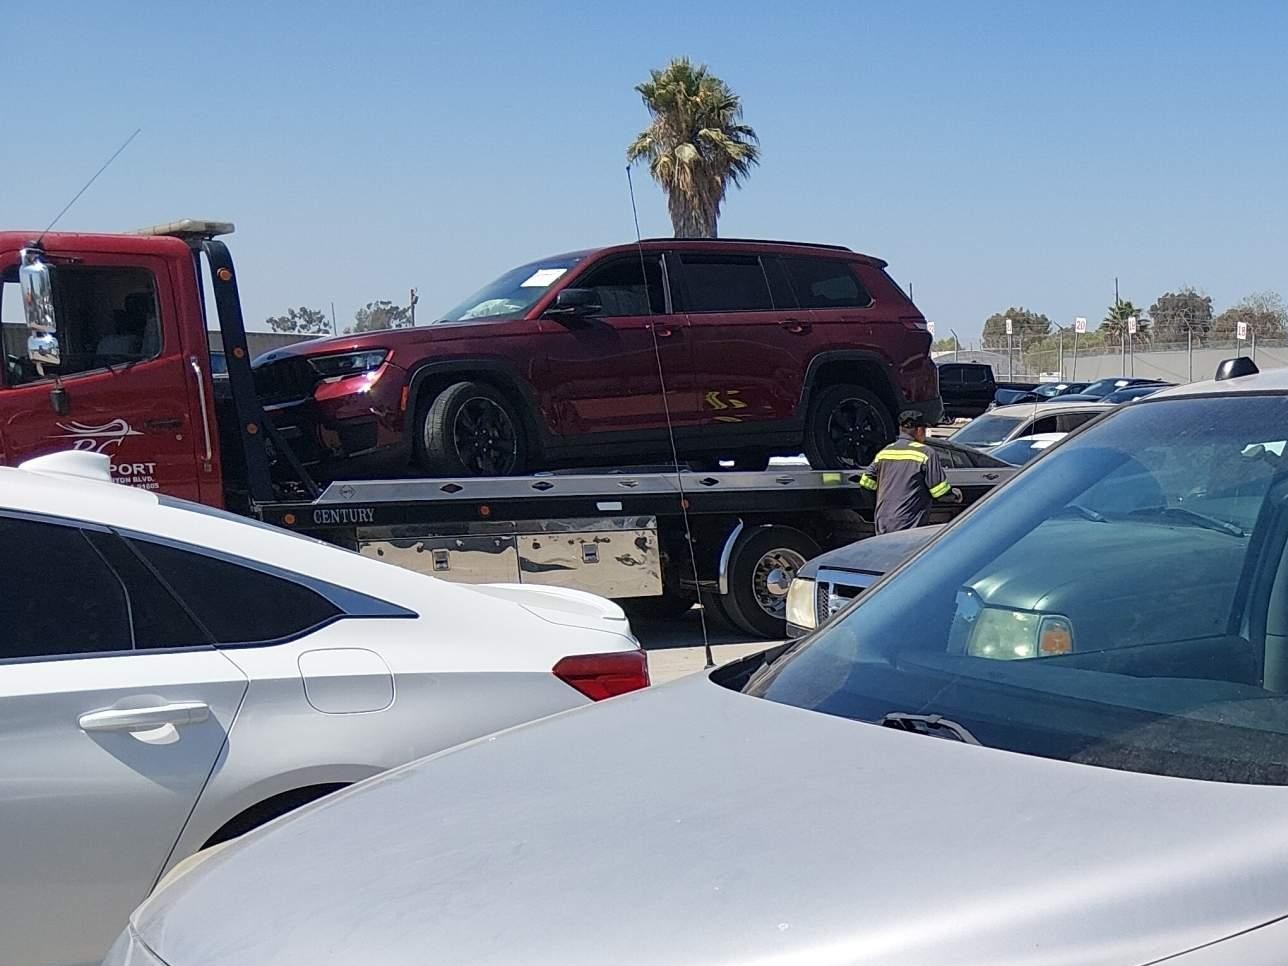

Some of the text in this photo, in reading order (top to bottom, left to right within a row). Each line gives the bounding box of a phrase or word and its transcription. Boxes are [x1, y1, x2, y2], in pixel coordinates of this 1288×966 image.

[1076, 320, 1086, 331] 20
[1238, 325, 1246, 336] 18
[110, 463, 156, 475] PORT
[313, 508, 375, 523] CENTURY
